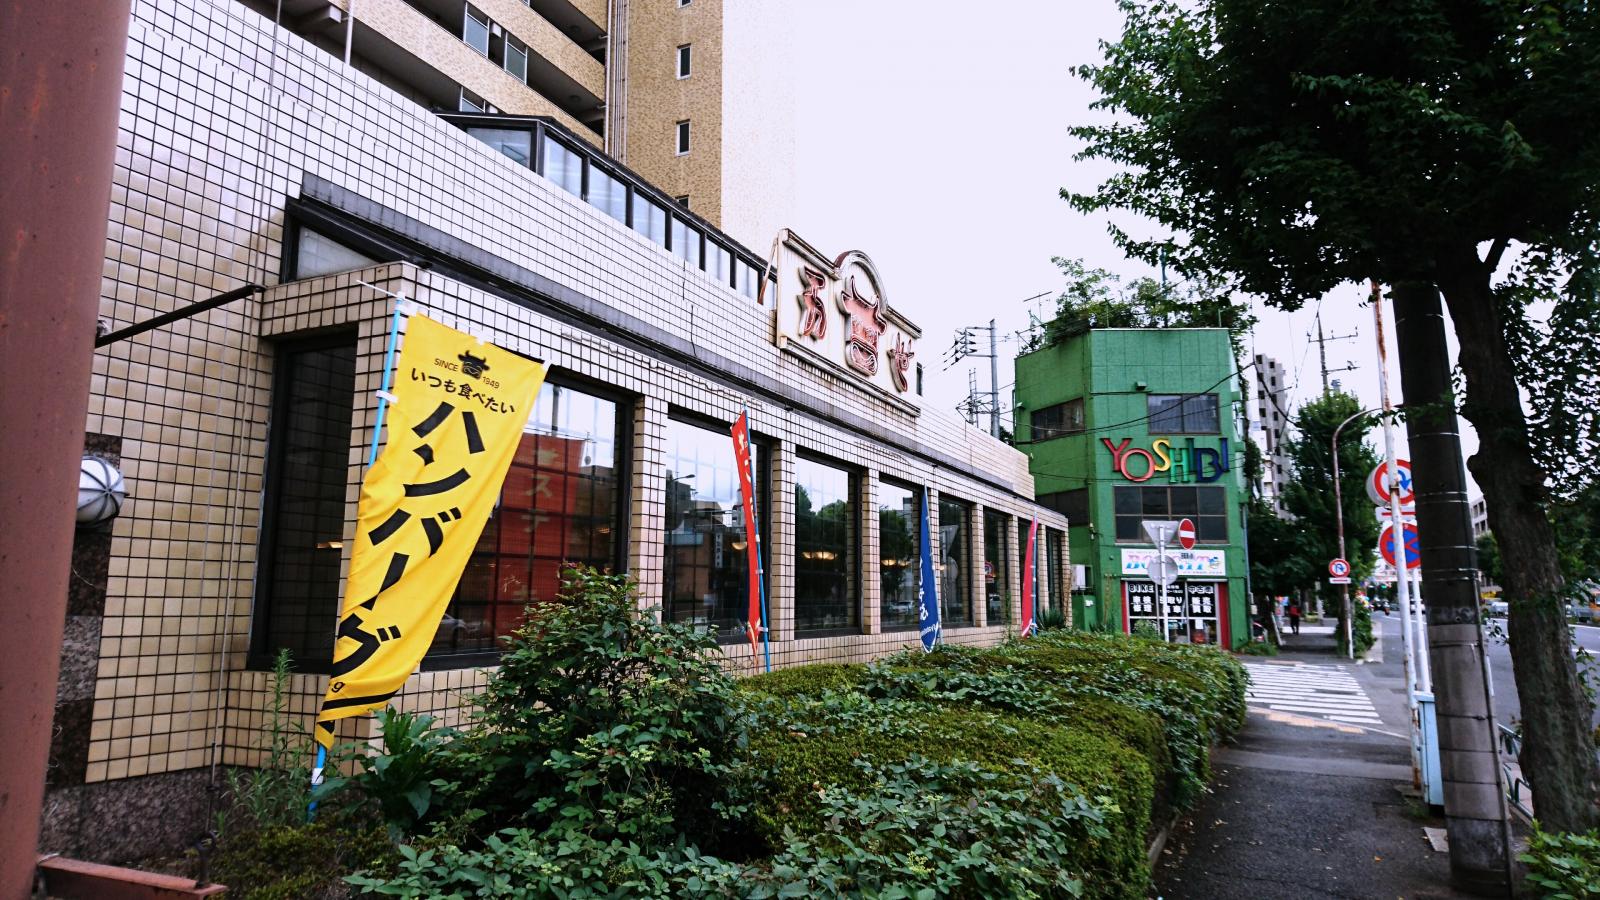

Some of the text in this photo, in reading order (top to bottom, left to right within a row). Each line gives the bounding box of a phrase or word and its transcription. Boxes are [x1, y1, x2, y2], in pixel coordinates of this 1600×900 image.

[411, 367, 515, 414] いつも食べたい
[434, 357, 501, 389] SINCE 1949
[1098, 437, 1230, 483] YOSHIBI
[330, 401, 486, 679] ハンバーグ
[1129, 584, 1154, 593] BIKE
